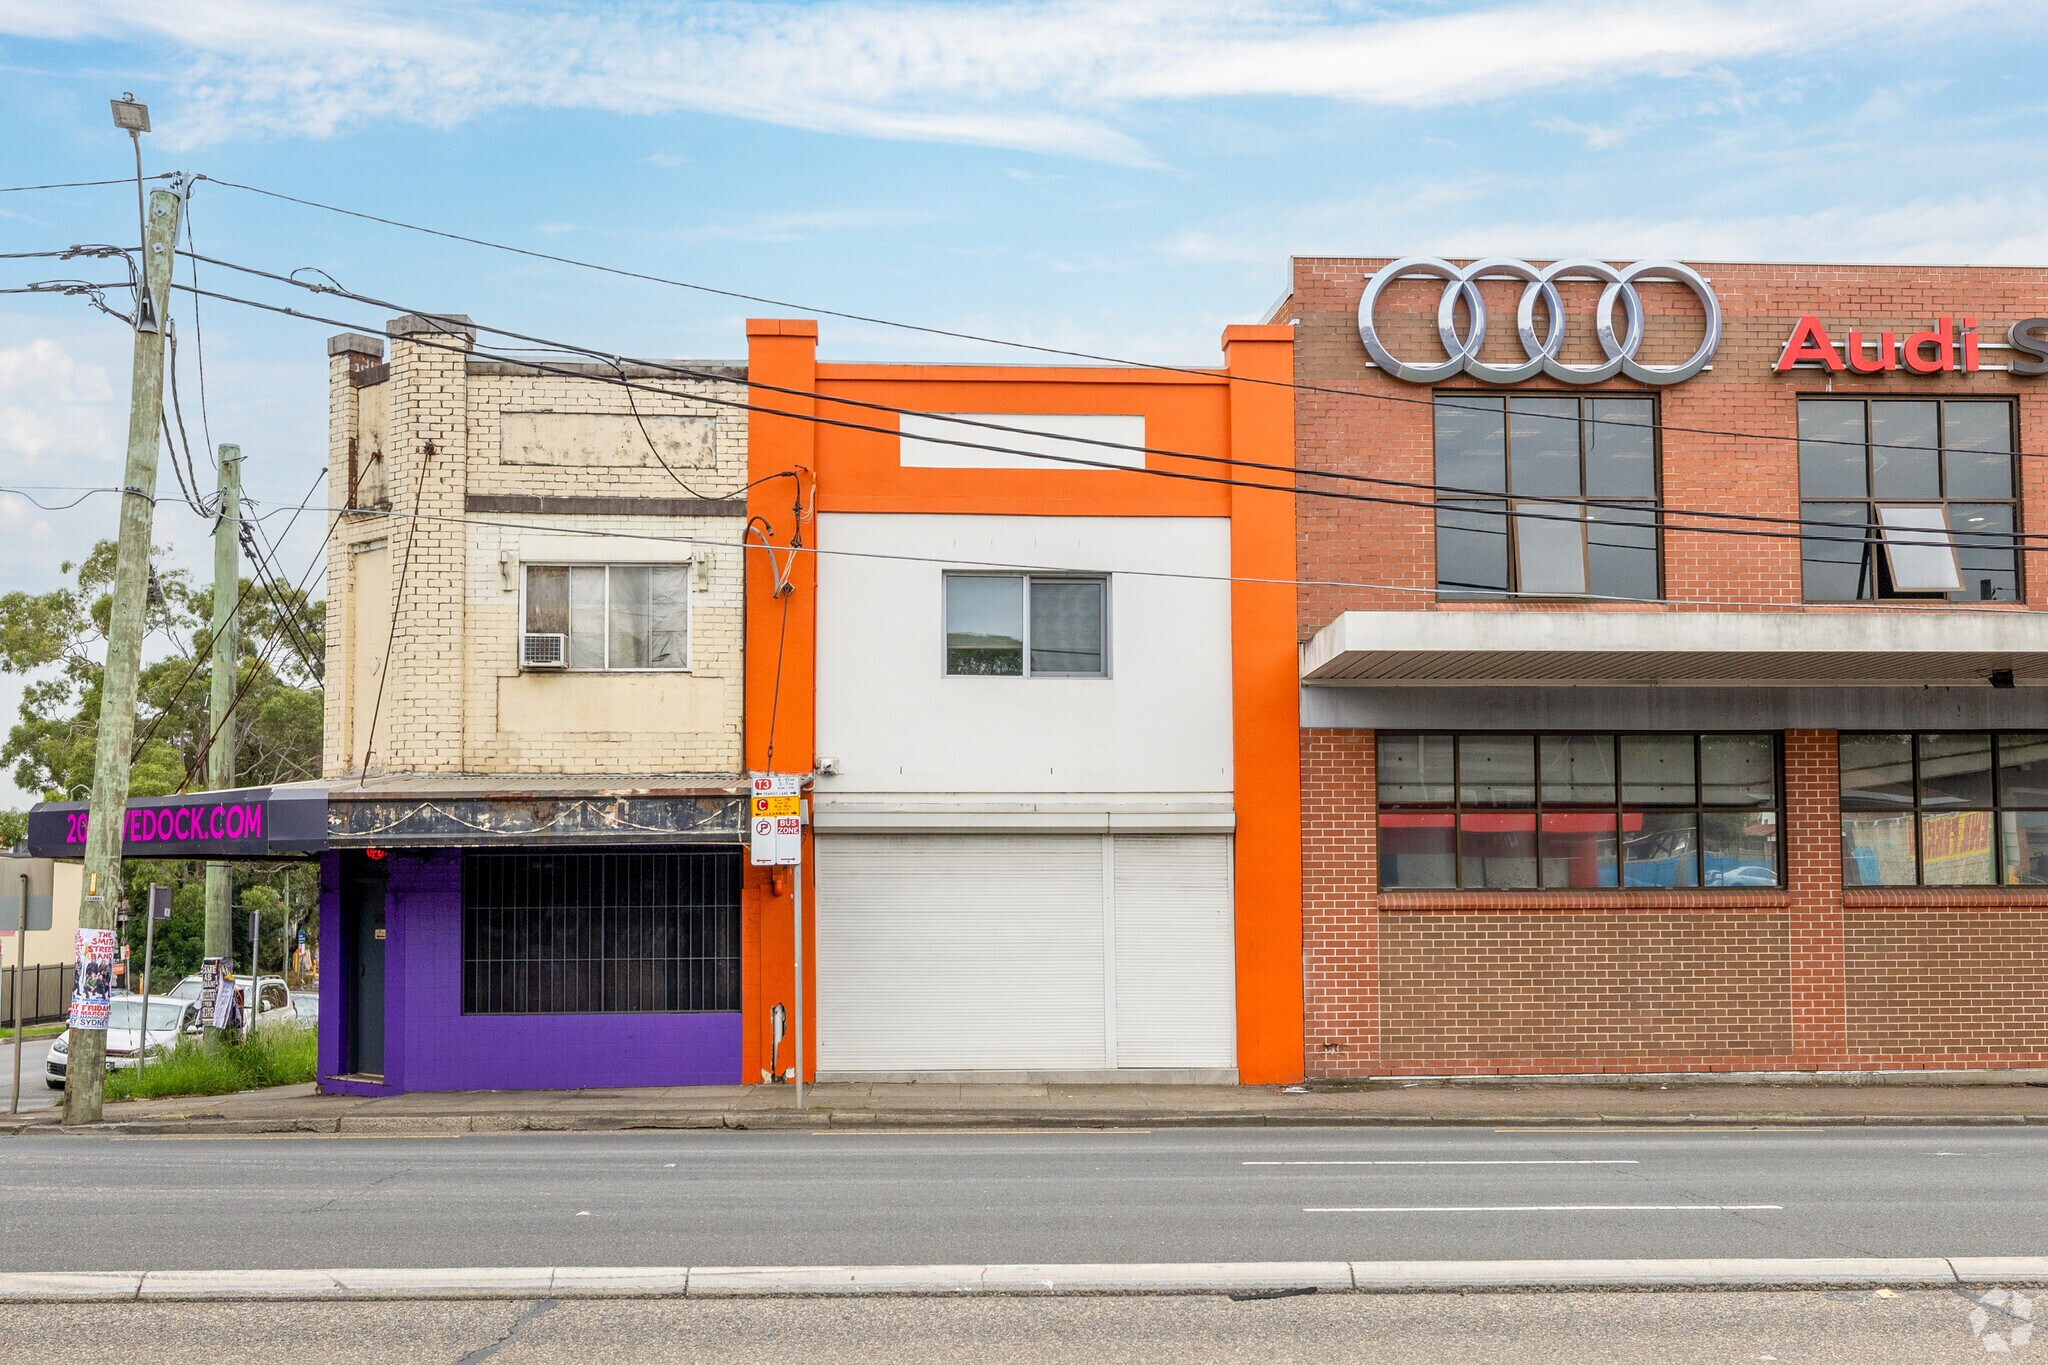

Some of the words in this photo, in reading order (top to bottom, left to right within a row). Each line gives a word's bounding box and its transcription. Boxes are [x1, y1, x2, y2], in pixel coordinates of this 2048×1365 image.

[1773, 316, 1979, 374] Audi
[757, 780, 770, 789] T3
[759, 800, 766, 810] C
[88, 945, 114, 953] STREET
